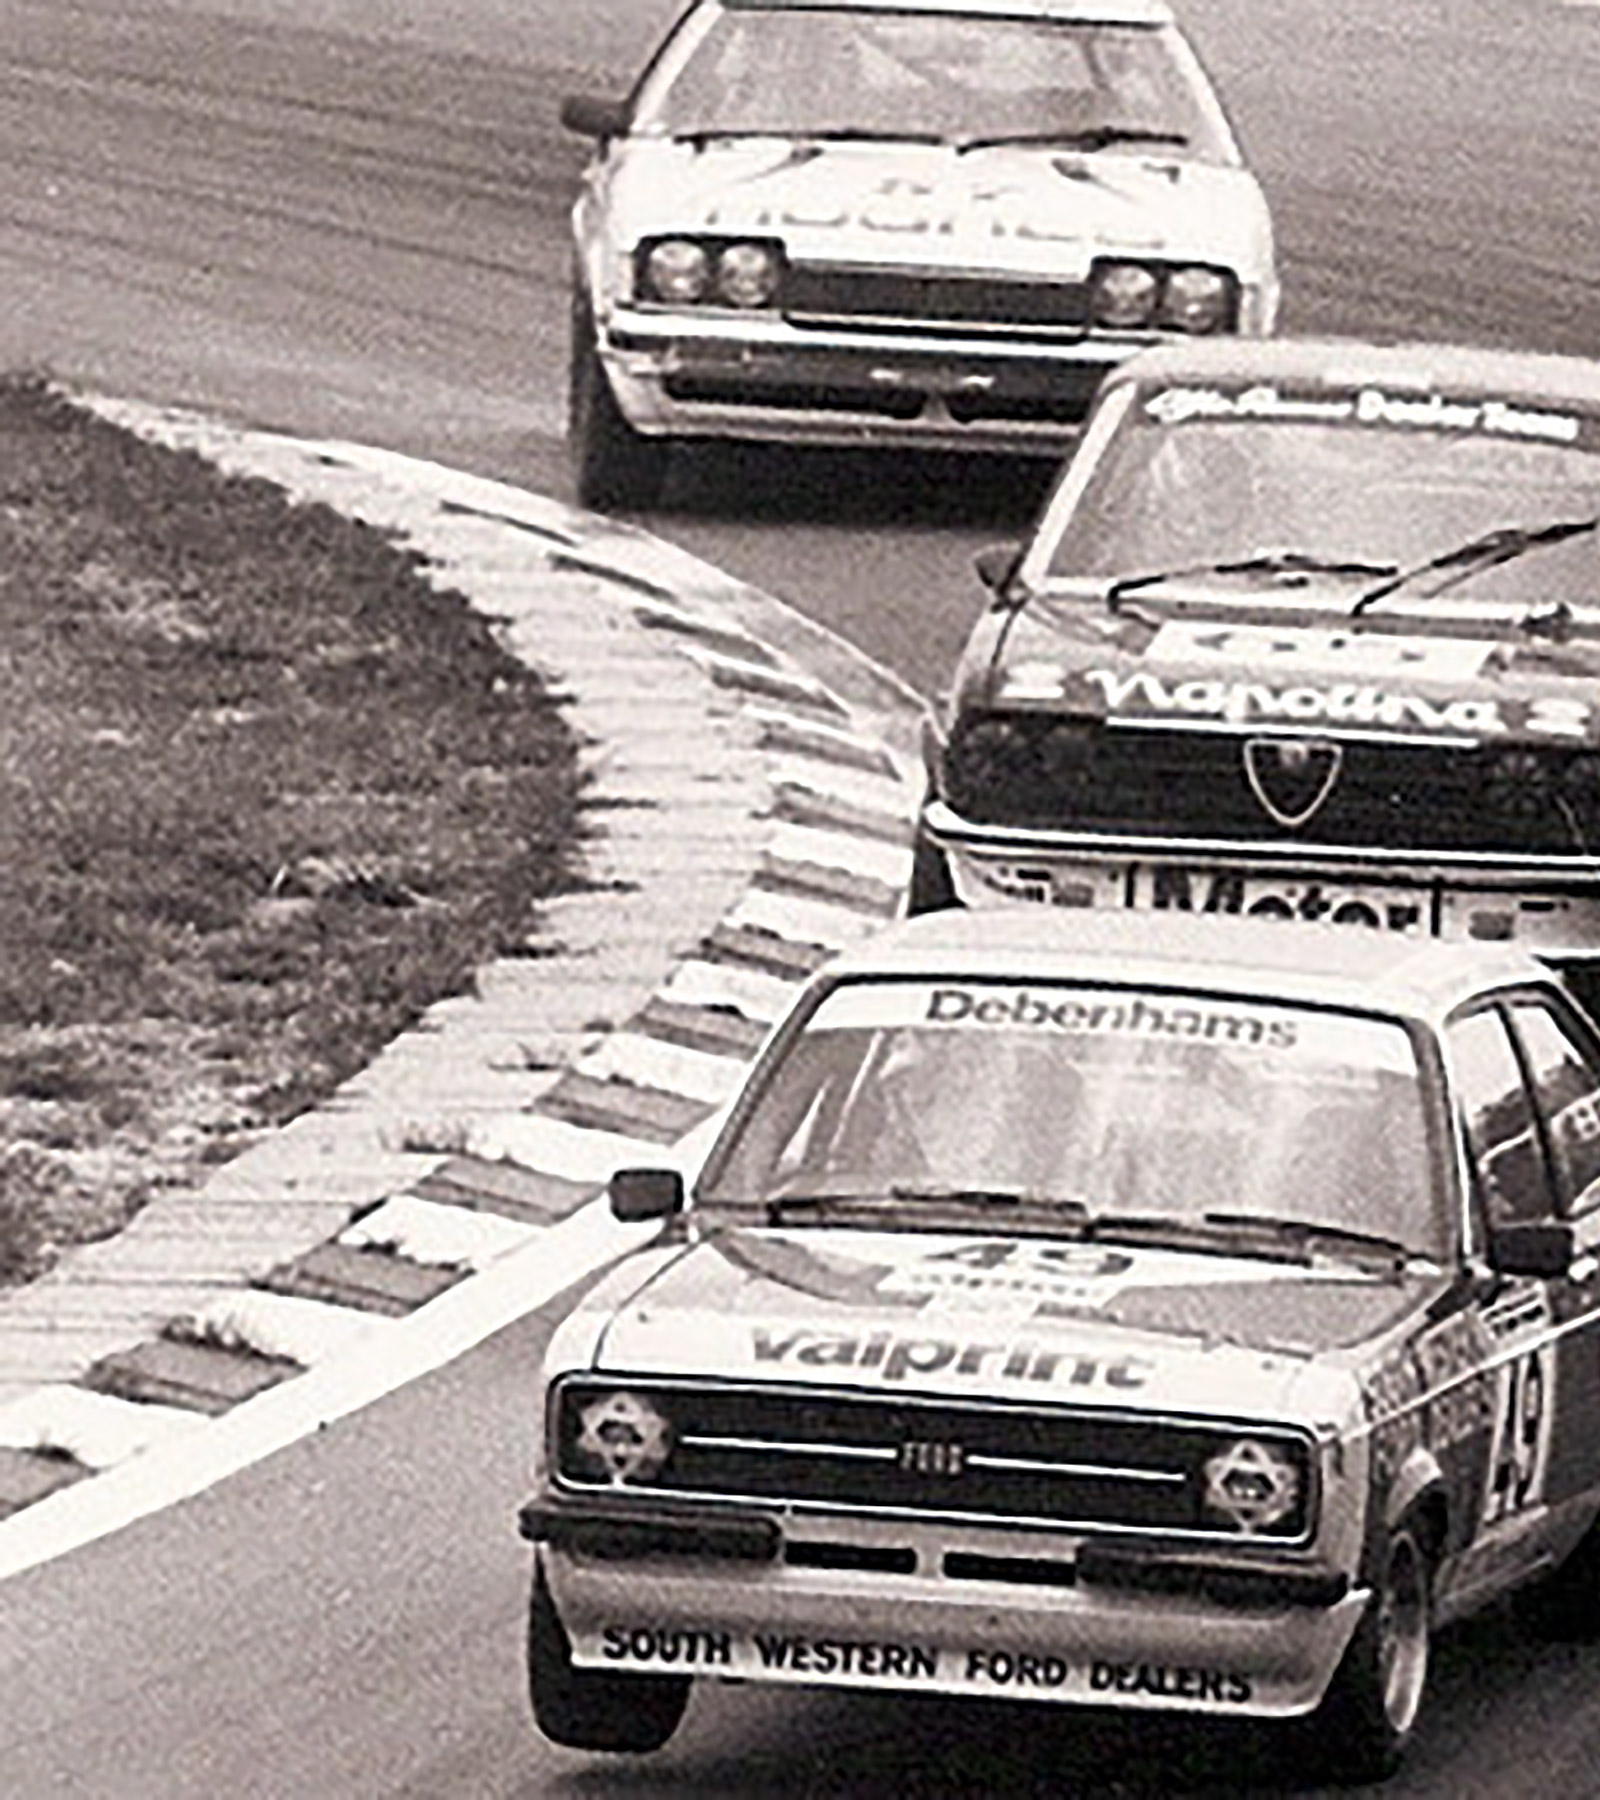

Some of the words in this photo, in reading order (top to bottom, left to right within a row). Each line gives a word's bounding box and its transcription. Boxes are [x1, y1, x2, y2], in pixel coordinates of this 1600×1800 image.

[924, 988, 1298, 1049] Debenhams
[602, 1625, 731, 1665] SOUTH
[753, 1633, 937, 1679] WESTERN
[963, 1649, 1068, 1686] FORD
[1089, 1661, 1252, 1703] DEALERS
